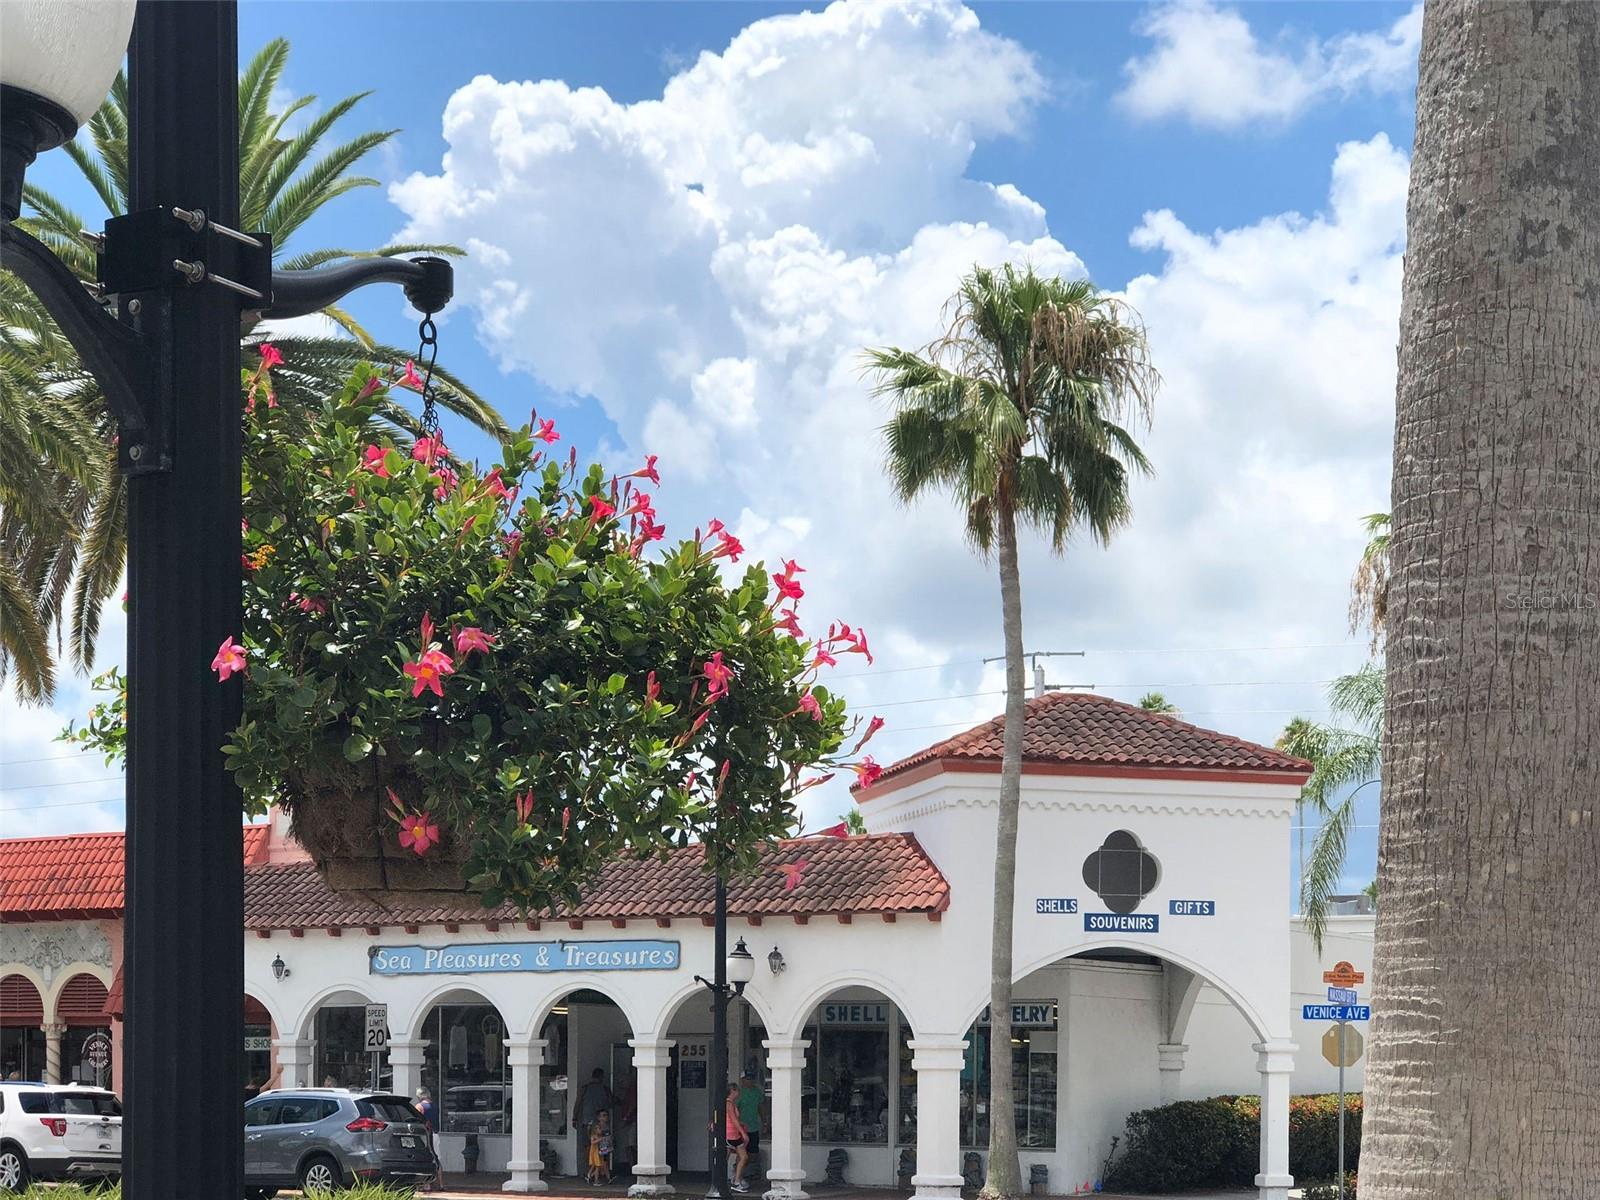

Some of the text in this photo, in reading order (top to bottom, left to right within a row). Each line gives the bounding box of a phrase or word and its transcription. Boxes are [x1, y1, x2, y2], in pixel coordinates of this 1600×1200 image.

[1037, 900, 1077, 913] SHELLS
[1175, 902, 1210, 914] GIFTS
[1090, 916, 1154, 930] SOUVENIRS
[375, 945, 676, 970] Sea Pleasures & Treasures
[368, 1009, 386, 1018] SPEED
[826, 1005, 886, 1022] SHELL
[981, 1005, 1050, 1022] JELRY
[1306, 1006, 1367, 1019] VENICE AVE
[369, 1019, 384, 1027] LIMIT
[368, 1029, 384, 1046] 20
[681, 1044, 707, 1057] 255
